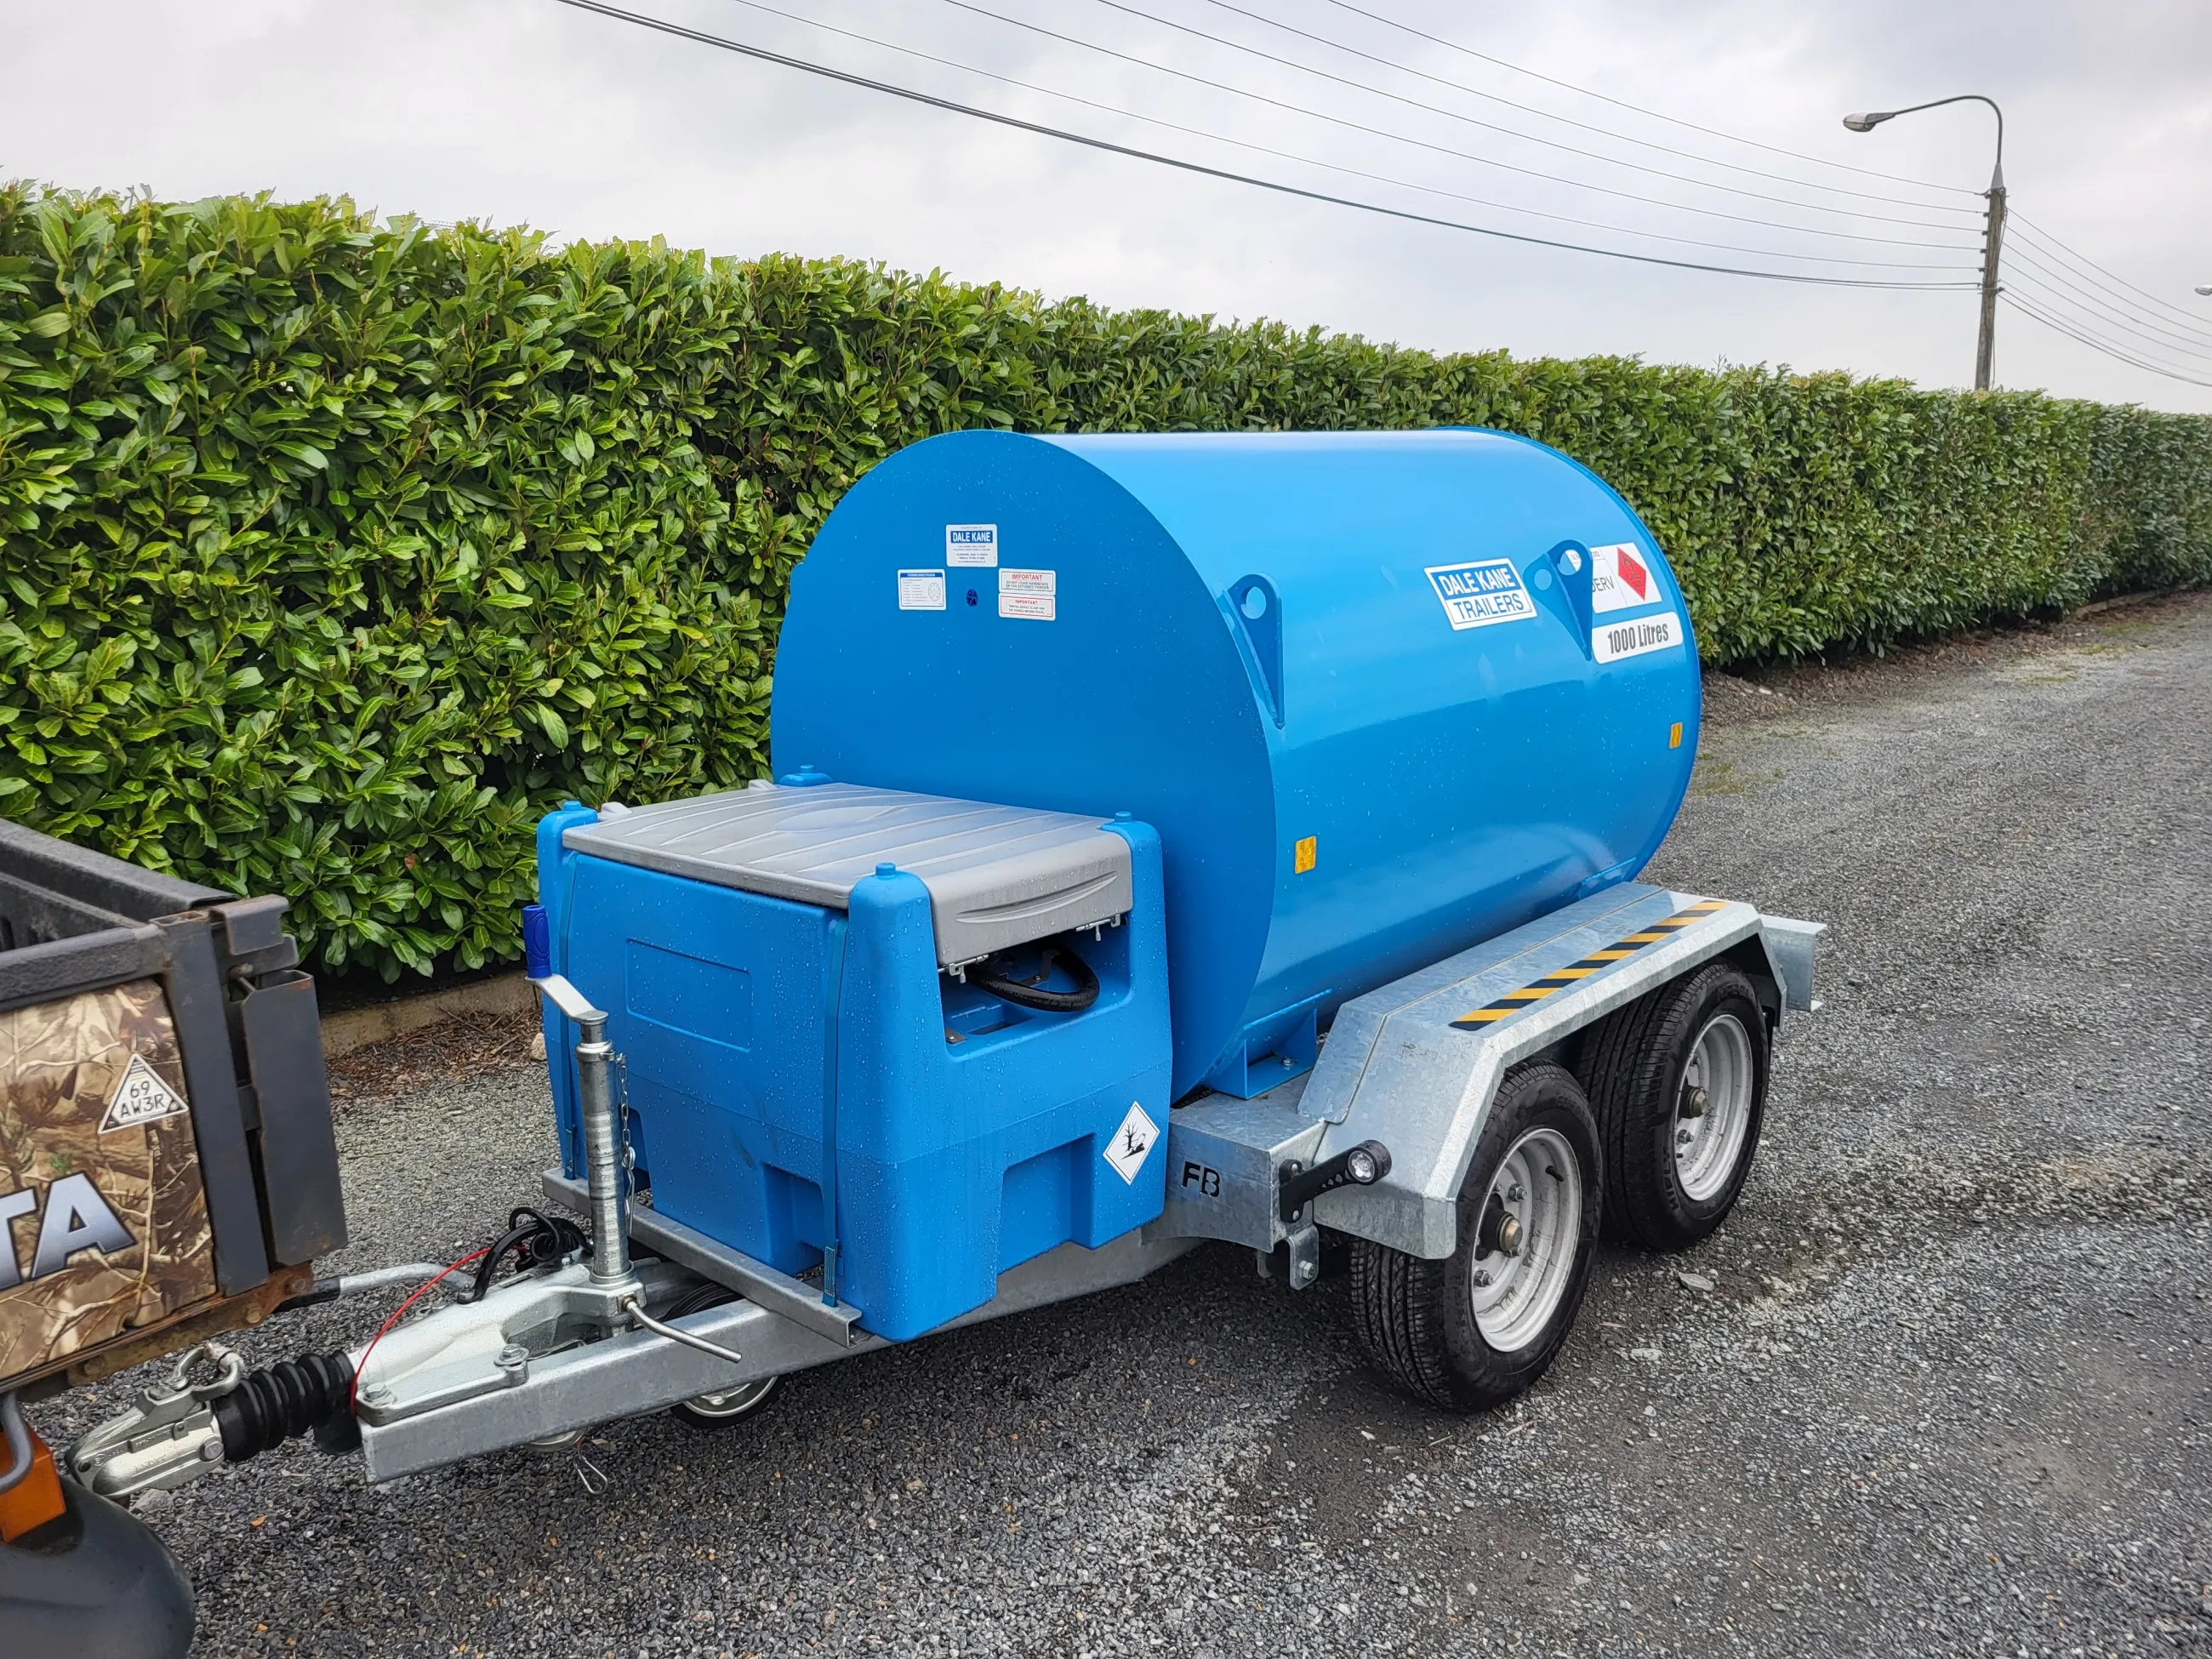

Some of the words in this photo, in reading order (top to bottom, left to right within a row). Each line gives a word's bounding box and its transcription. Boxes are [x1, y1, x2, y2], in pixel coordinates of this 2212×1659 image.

[953, 532, 970, 542] DALE
[972, 532, 990, 542] KANE
[1438, 573, 1479, 596] DALE
[1474, 567, 1516, 591] KANE
[1453, 593, 1525, 619] TRAILERS
[1607, 627, 1636, 654] 1000
[1637, 624, 1669, 647] Litres
[130, 1080, 150, 1098] 69
[121, 1093, 167, 1119] AW3R
[1182, 1160, 1220, 1198] FB
